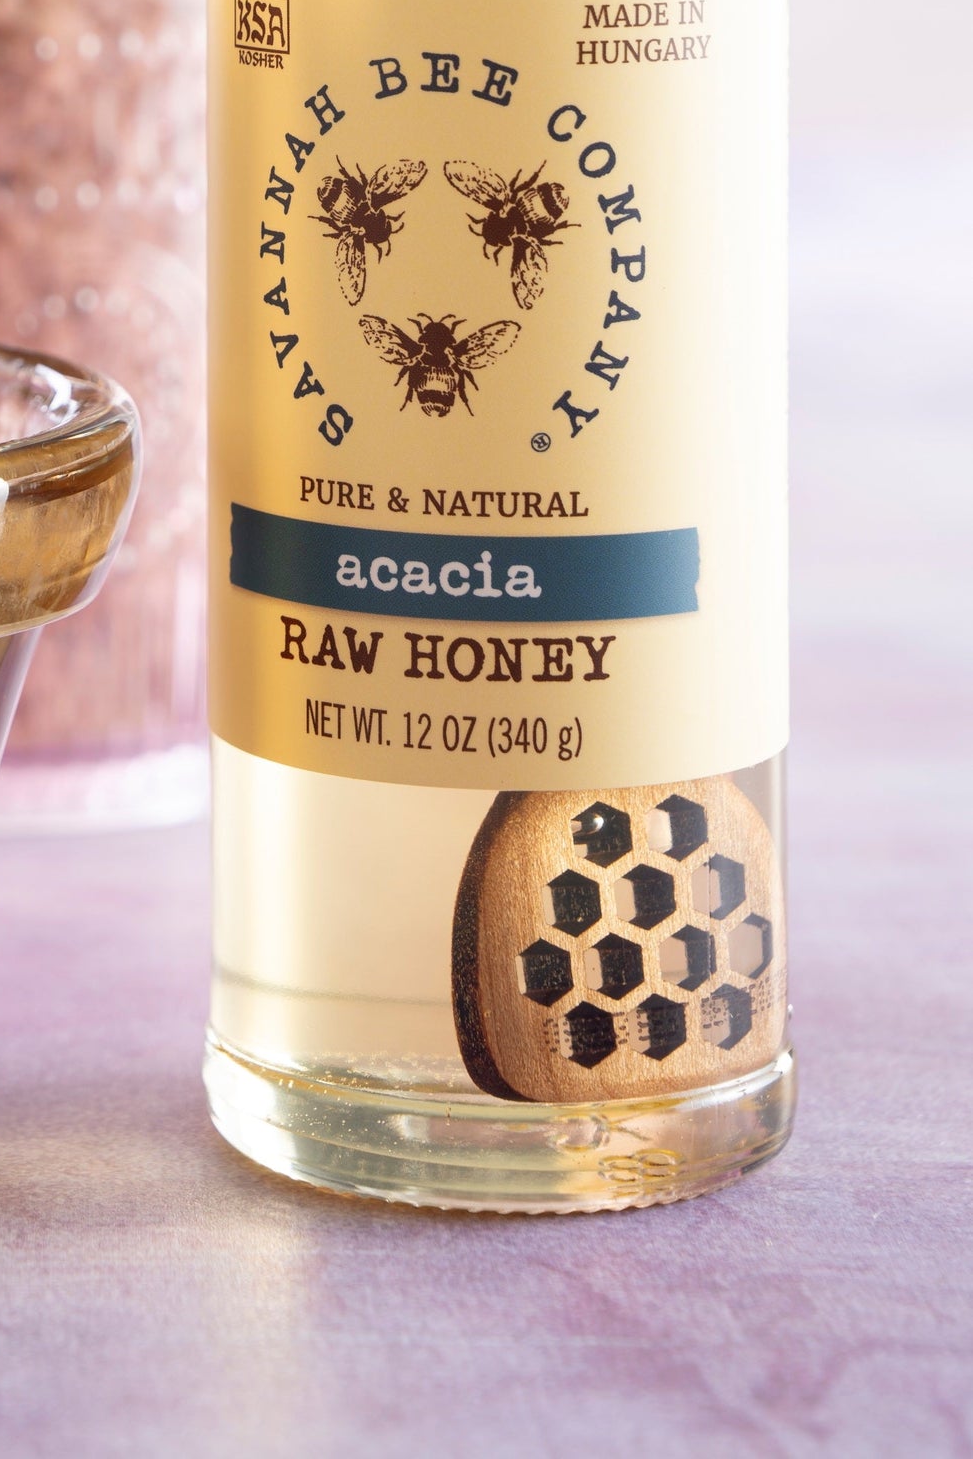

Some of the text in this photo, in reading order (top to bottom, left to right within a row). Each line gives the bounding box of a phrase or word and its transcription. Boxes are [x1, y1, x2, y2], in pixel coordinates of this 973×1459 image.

[583, 0, 706, 29] MADE IN
[238, 49, 285, 70] KOSHER
[576, 34, 712, 65] HUNGARY
[260, 84, 354, 446] SAVANNAH
[369, 51, 519, 106] BEE
[547, 104, 647, 438] COMPANY
[300, 476, 589, 518] PURE & NATURAL
[335, 550, 542, 599] acacia
[279, 615, 617, 683] RAW HONEY
[305, 698, 583, 762] NET WT. 12 OZ (340 g)
